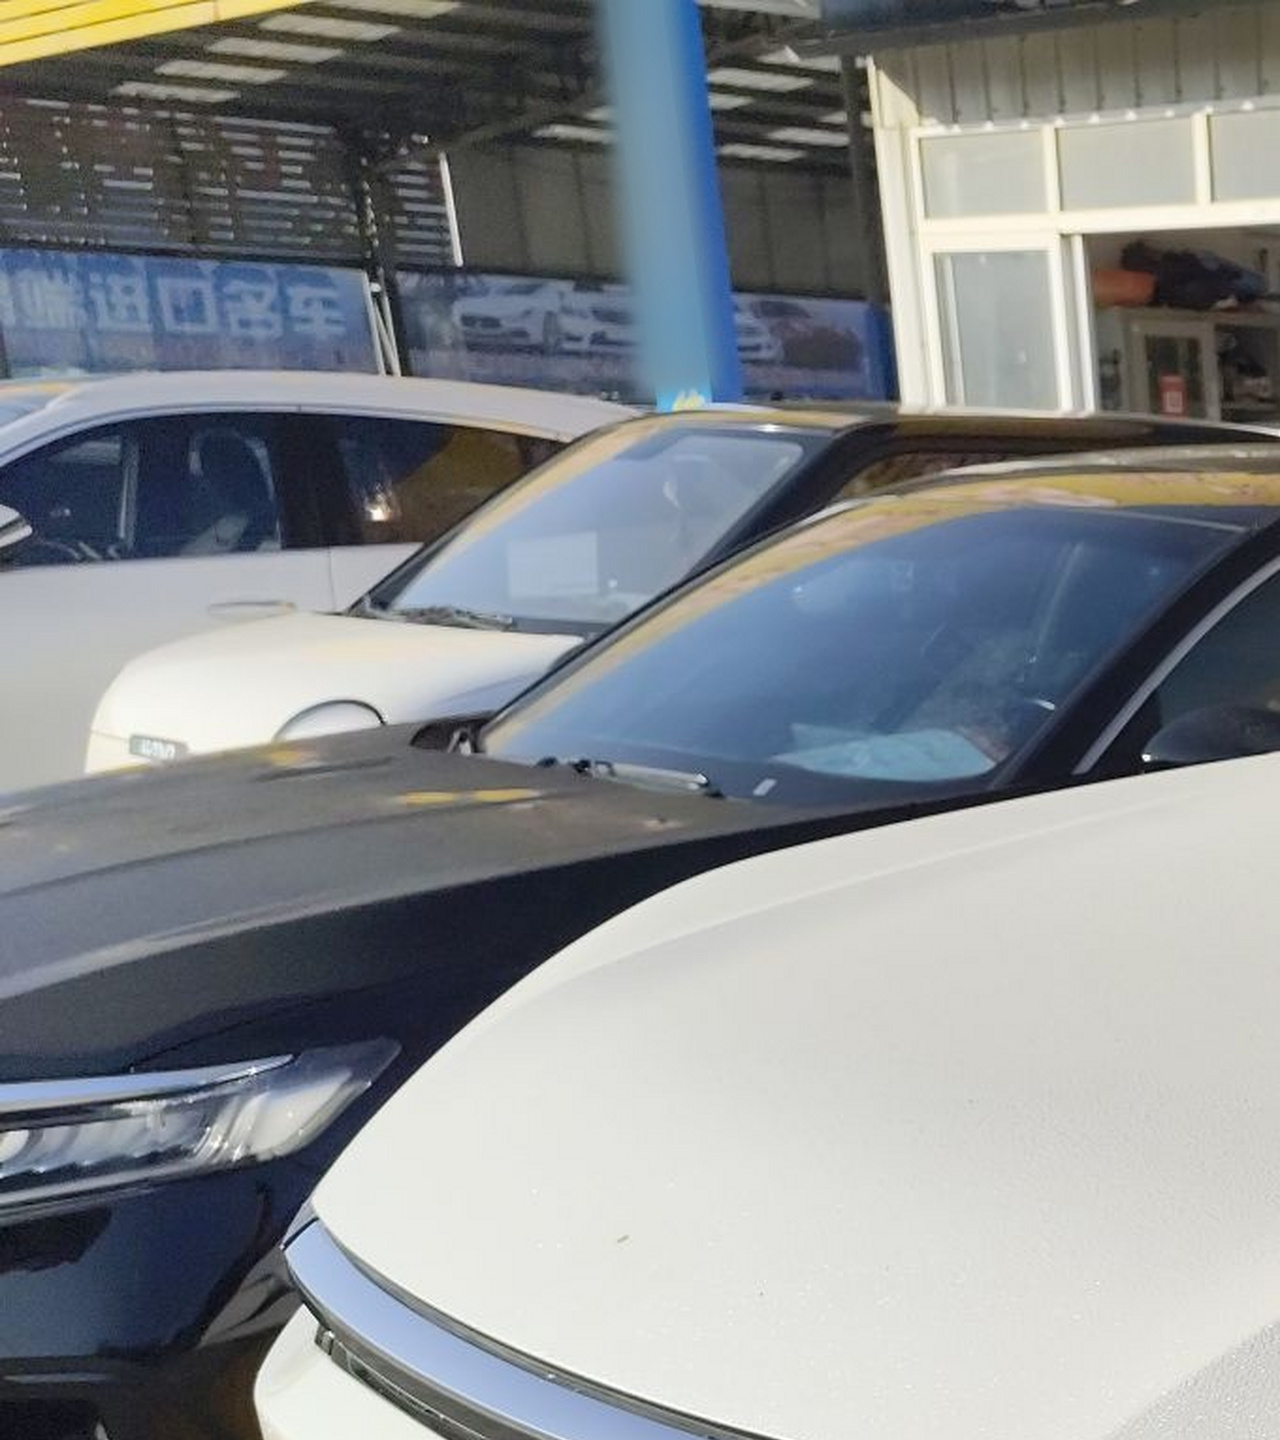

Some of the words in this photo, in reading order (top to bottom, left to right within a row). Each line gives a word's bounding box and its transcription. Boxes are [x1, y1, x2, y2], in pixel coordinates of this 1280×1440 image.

[0, 268, 347, 340] 端进口名车
